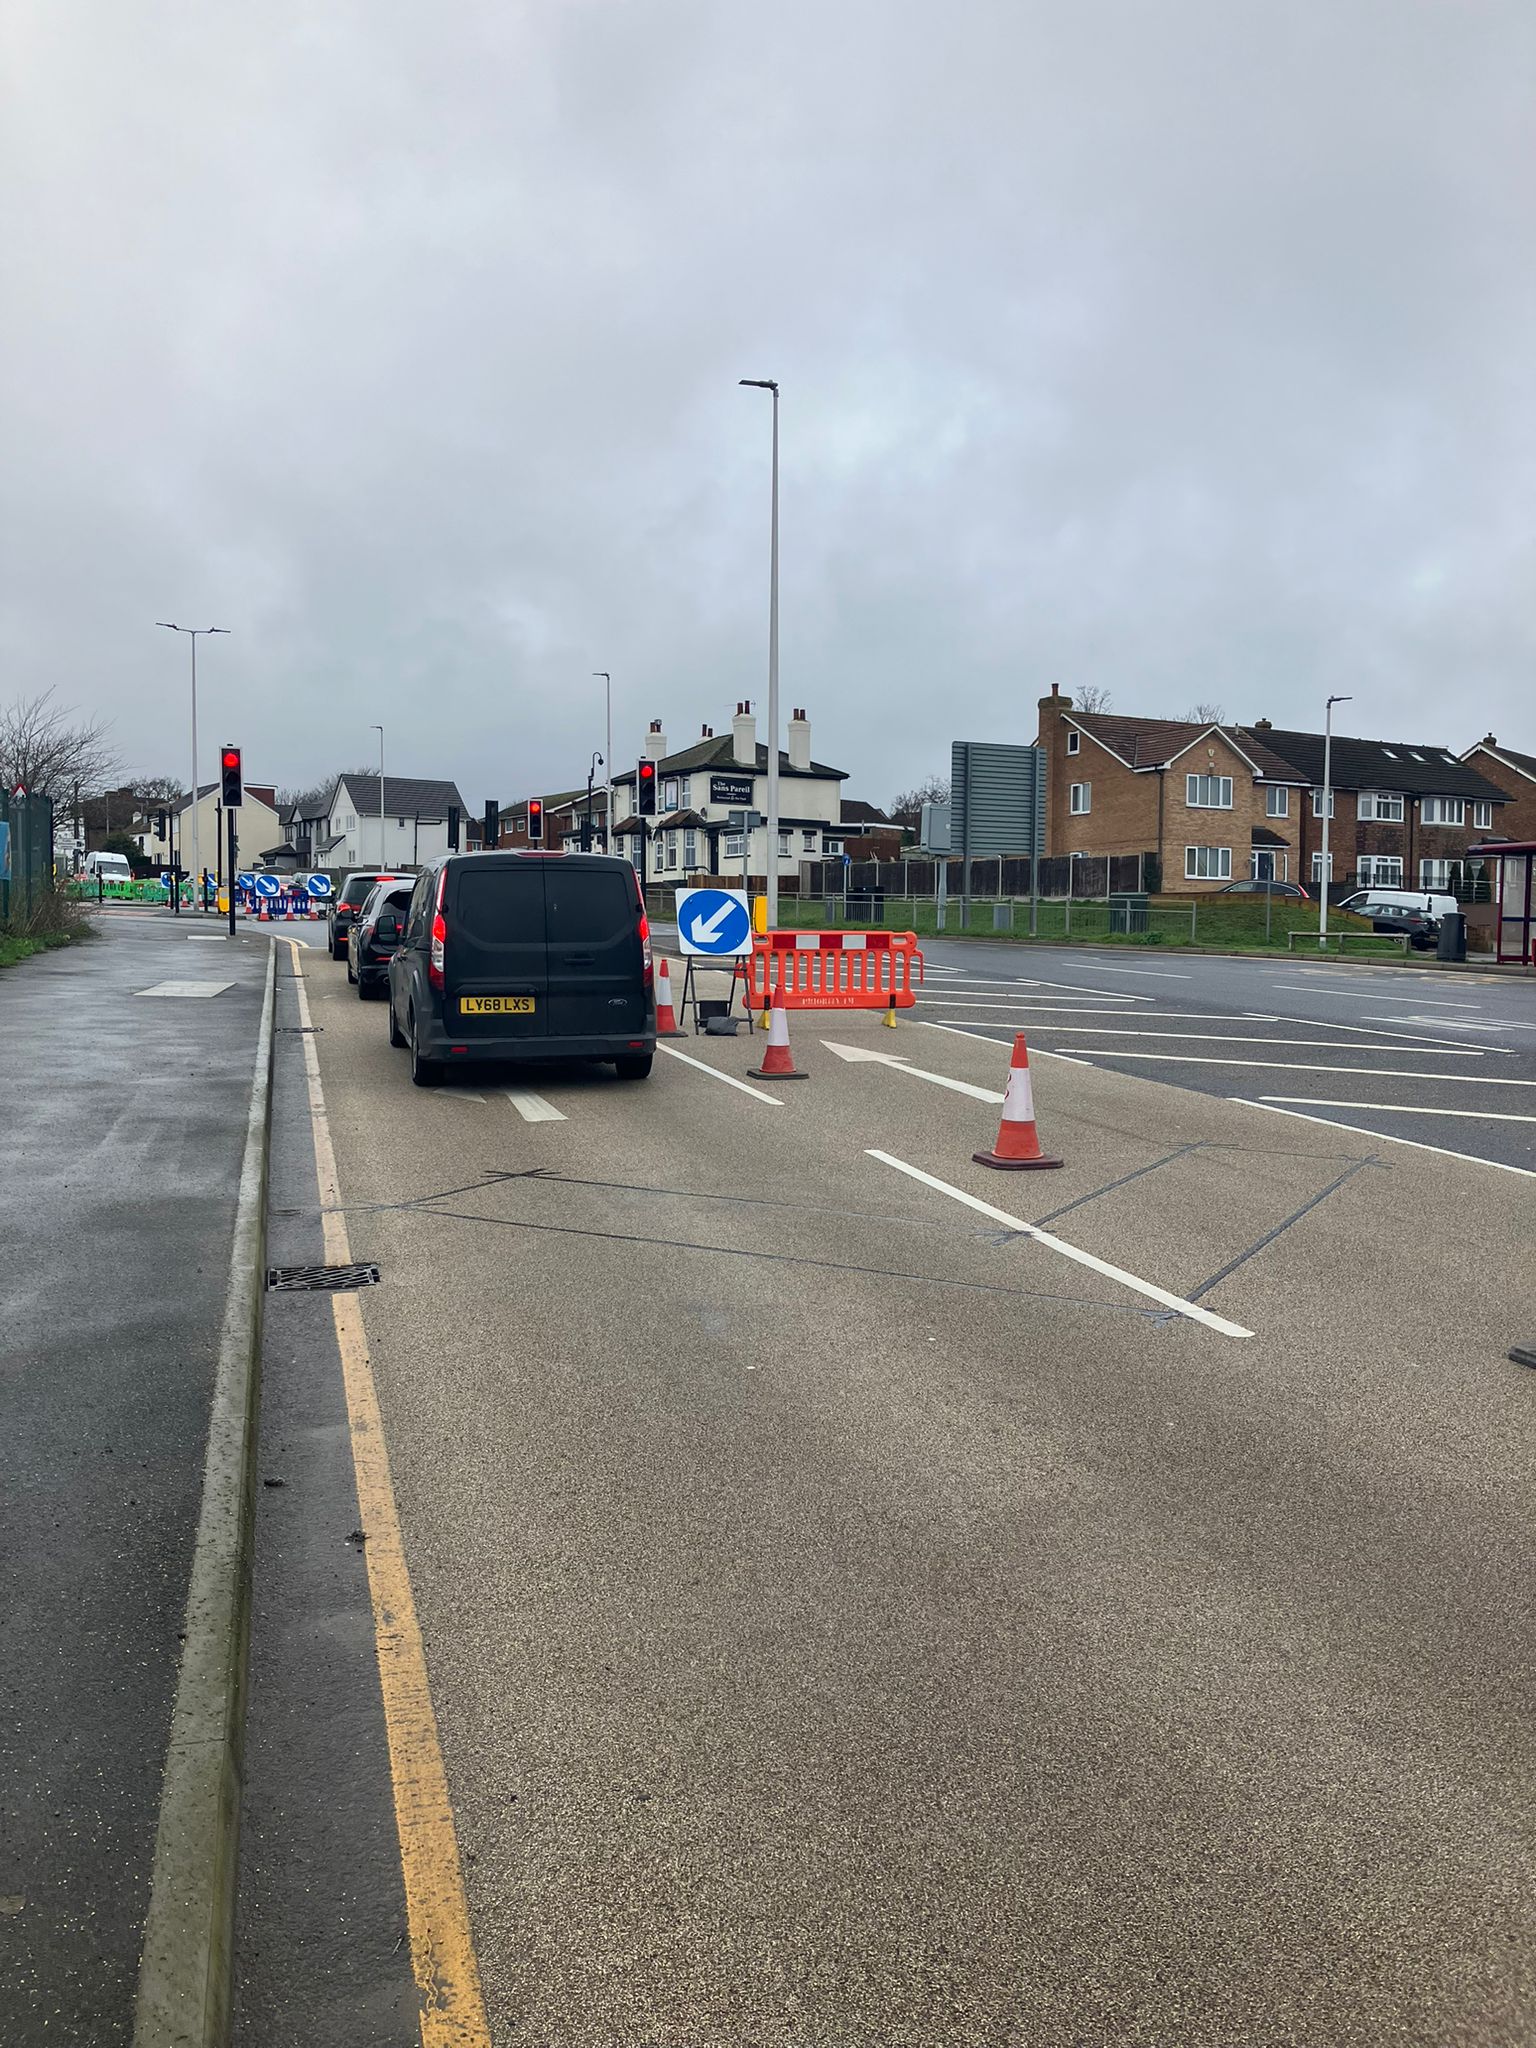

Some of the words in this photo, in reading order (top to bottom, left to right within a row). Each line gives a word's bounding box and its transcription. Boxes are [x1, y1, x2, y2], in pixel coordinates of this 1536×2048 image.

[730, 785, 750, 793] Pareil
[466, 999, 501, 1011] LY68
[504, 999, 530, 1011] LXS
